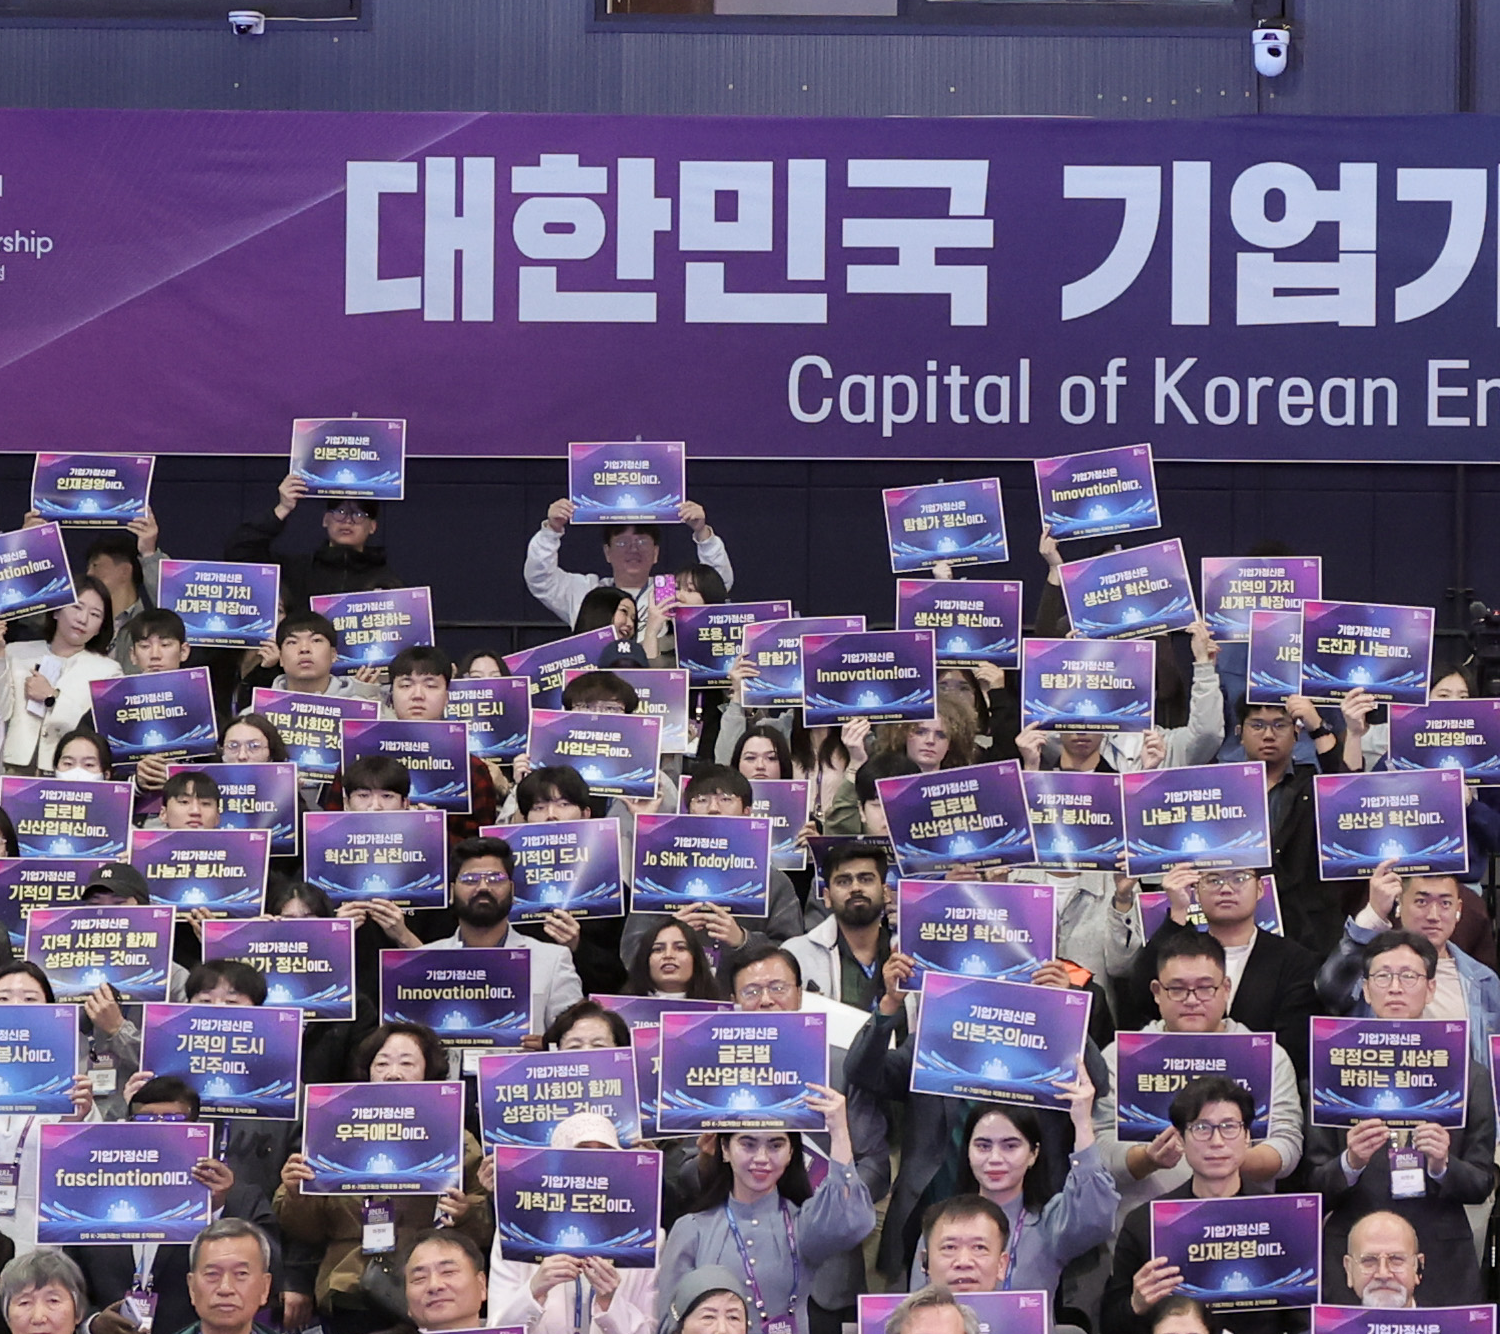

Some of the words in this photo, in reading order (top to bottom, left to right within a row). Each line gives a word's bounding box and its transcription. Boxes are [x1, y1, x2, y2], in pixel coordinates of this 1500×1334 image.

[344, 153, 994, 326] 대한민국
[788, 355, 1030, 438] Capital
[1060, 357, 1127, 425] of
[1154, 357, 1398, 426] Korean
[313, 447, 380, 461] 인본주의이다.
[1316, 637, 1357, 656] 도전과
[1364, 641, 1412, 659] 나눔이다.
[189, 1018, 254, 1033] 기업가정신은
[176, 1034, 227, 1054] 기적의
[230, 1036, 264, 1055] 도시
[189, 1056, 250, 1075] 진주이다.
